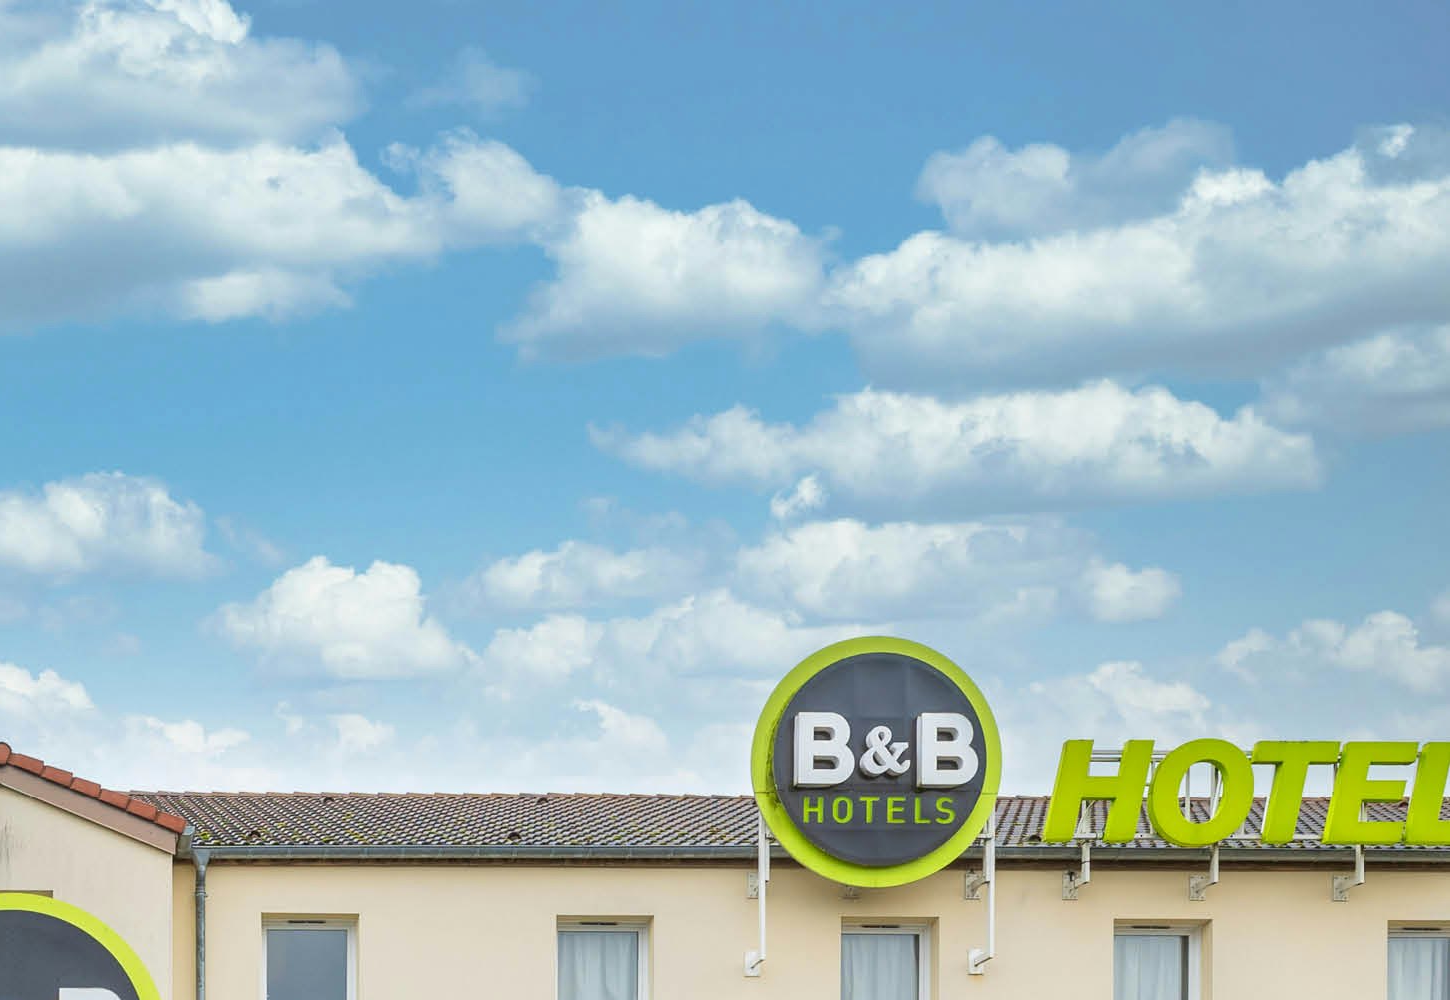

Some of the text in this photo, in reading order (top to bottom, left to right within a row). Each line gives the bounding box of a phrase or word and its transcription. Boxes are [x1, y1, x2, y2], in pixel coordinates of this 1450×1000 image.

[793, 712, 979, 789] B&B
[802, 796, 956, 825] HOTELS
[1043, 738, 1450, 847] HOTEL
